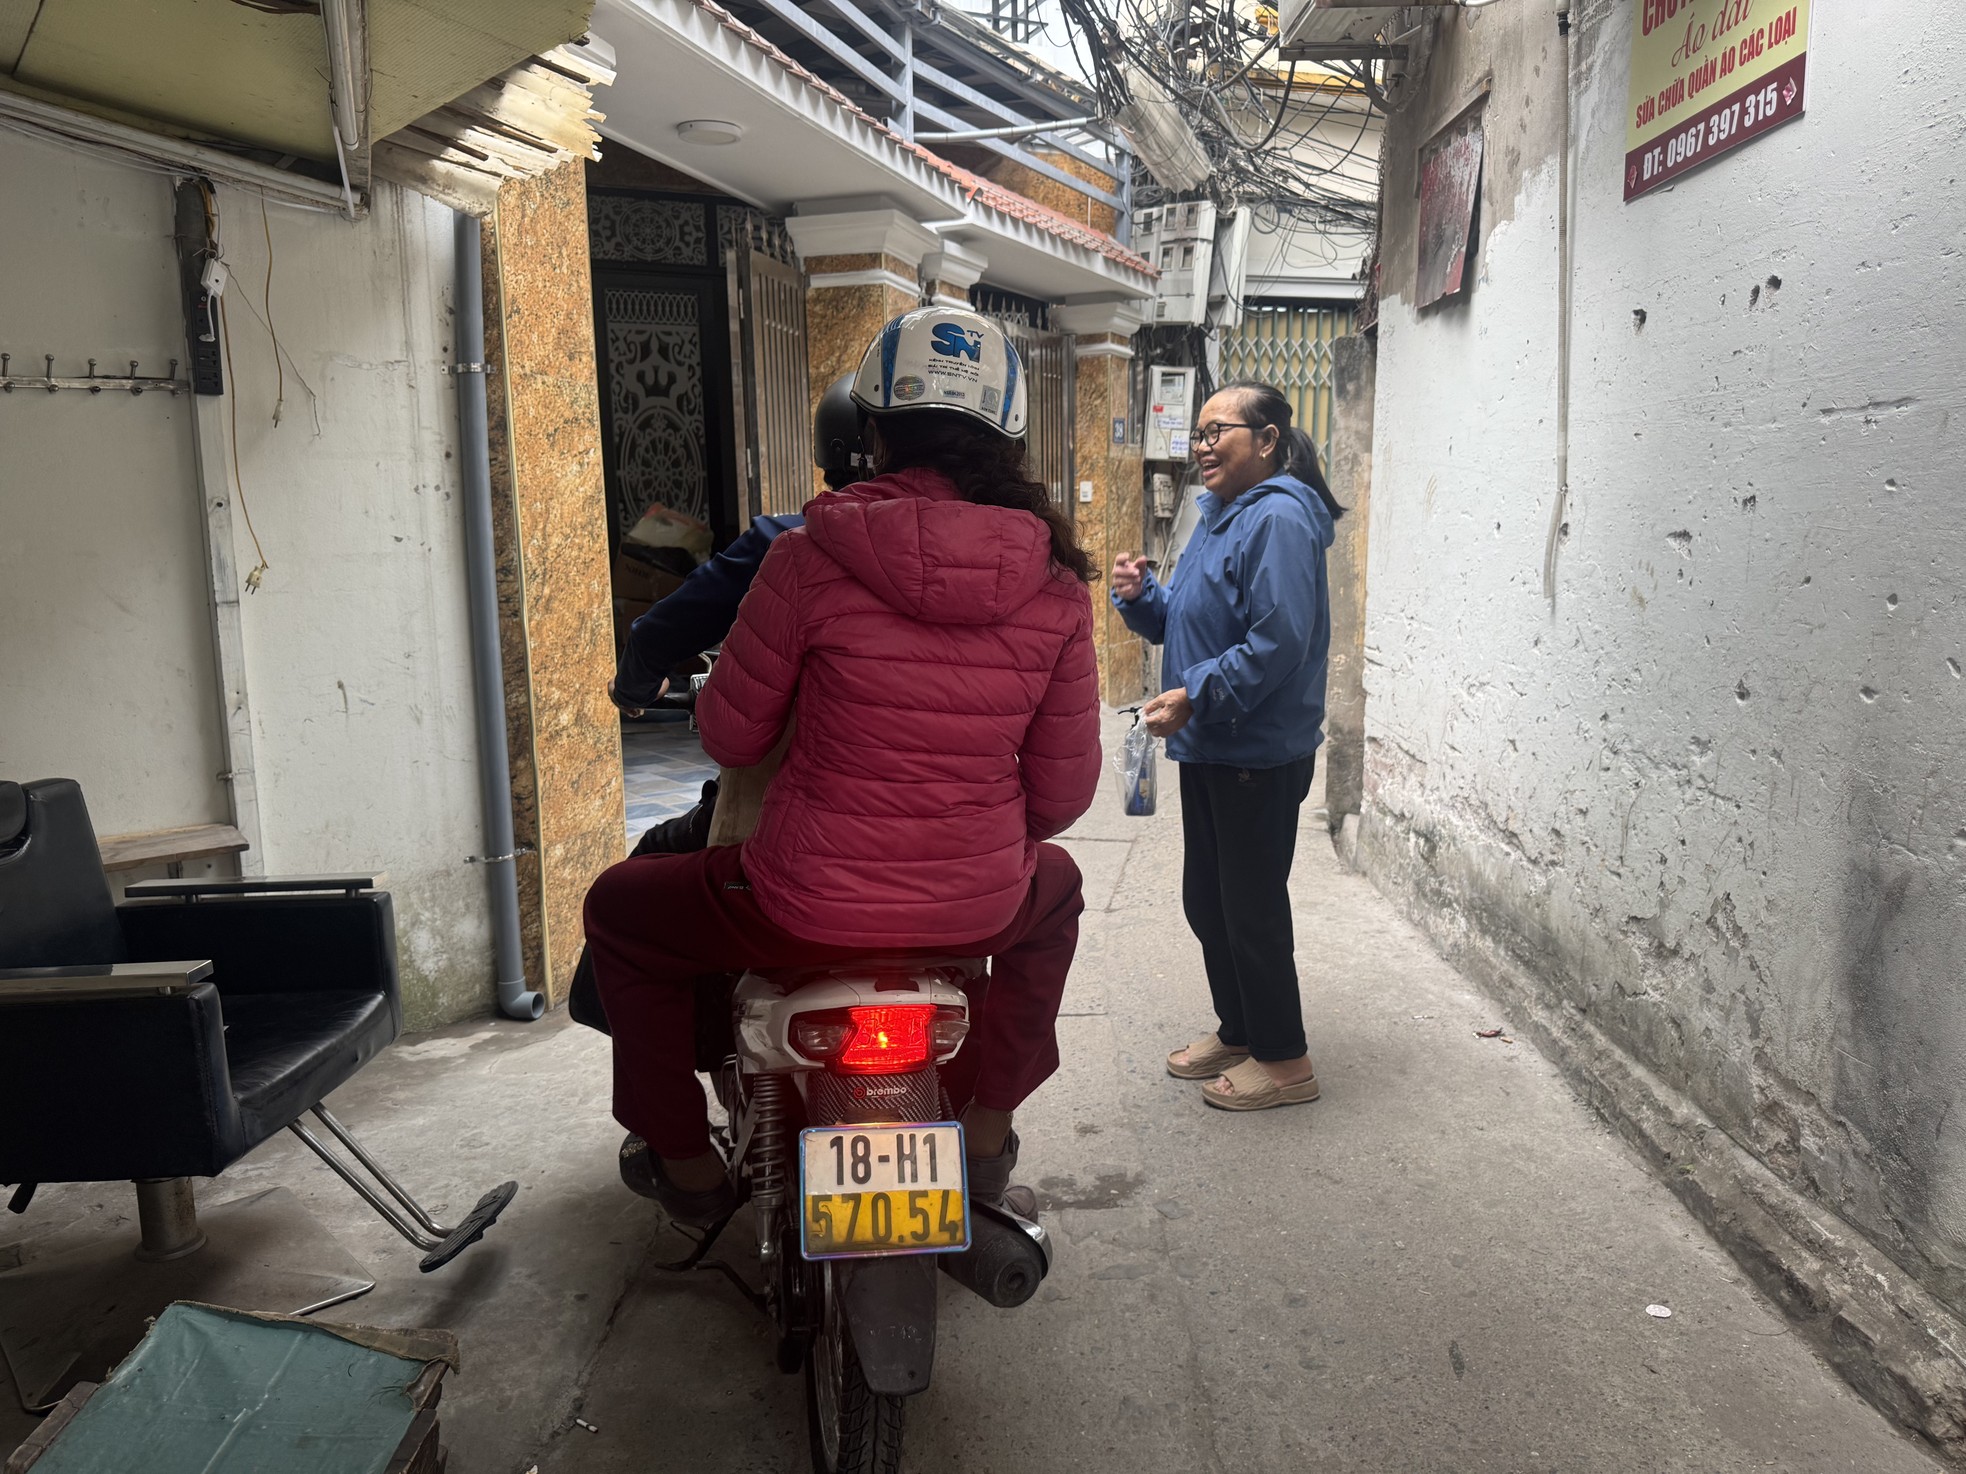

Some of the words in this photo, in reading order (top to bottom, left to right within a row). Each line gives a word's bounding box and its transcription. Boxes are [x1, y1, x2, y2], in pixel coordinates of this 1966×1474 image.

[1657, 77, 1685, 117] CHỮA
[1687, 54, 1718, 99] QUẦN
[1718, 46, 1736, 79] ÁO
[1738, 27, 1765, 67] CÁC
[1767, 6, 1797, 50] LOẠI
[1671, 11, 1708, 67] Áo
[1643, 146, 1663, 181] ĐT:
[1666, 121, 1706, 168] 0967
[1707, 101, 1741, 146] 397
[1743, 81, 1778, 128] 315
[866, 1086, 907, 1096] brembo
[829, 1132, 938, 1186] 18-H1
[810, 1189, 960, 1245] 570.54
